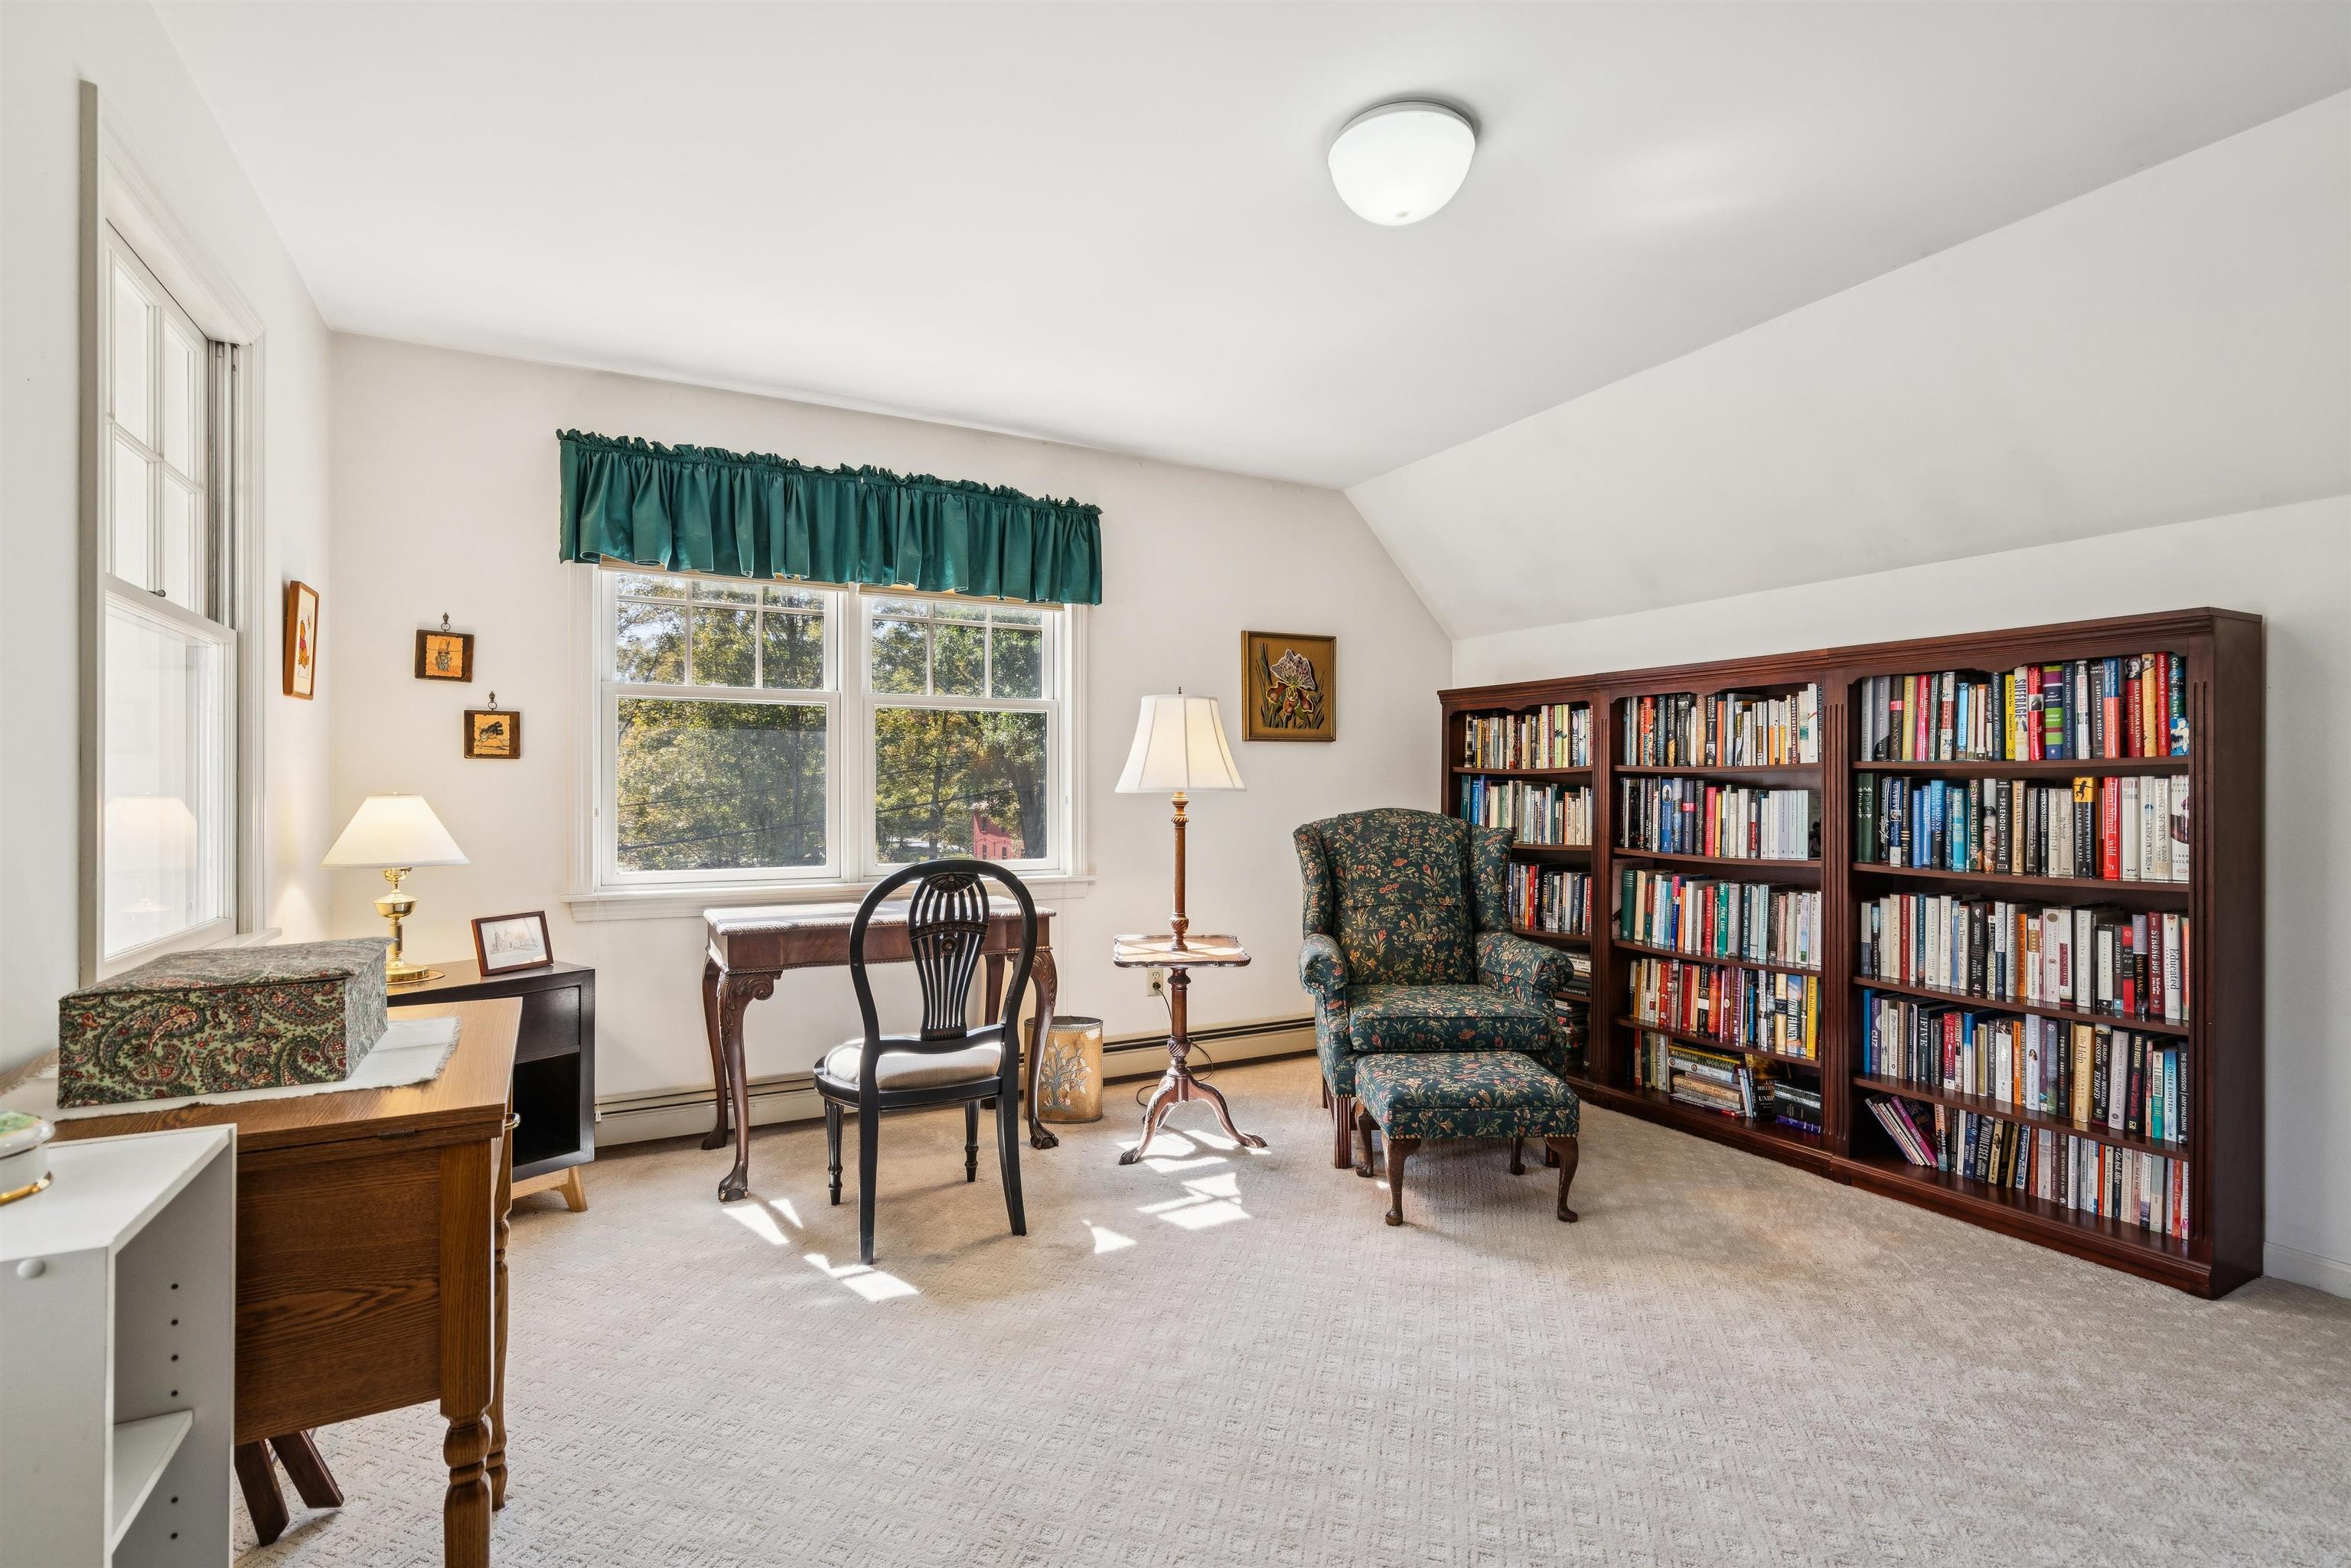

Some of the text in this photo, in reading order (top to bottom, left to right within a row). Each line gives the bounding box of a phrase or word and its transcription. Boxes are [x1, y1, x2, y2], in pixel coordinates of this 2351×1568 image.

[2014, 679, 2027, 719] SUFFRAGE
[2108, 839, 2118, 856] wild
[2062, 944, 2069, 952] ON
[2150, 930, 2160, 974] STRONG BOY
[2135, 955, 2144, 993] SUSIE YANG
[2169, 948, 2180, 990] Educated
[1808, 985, 1815, 994] Am
[1787, 1015, 1798, 1042] FRANZEN
[1919, 1020, 1929, 1047] FIVE
[2075, 1045, 2088, 1064] Help
[2093, 1070, 2102, 1100] ECHOED
[1978, 1126, 1992, 1162] MIDDLESEX
[2114, 1152, 2122, 1185] Go Ask Alice
